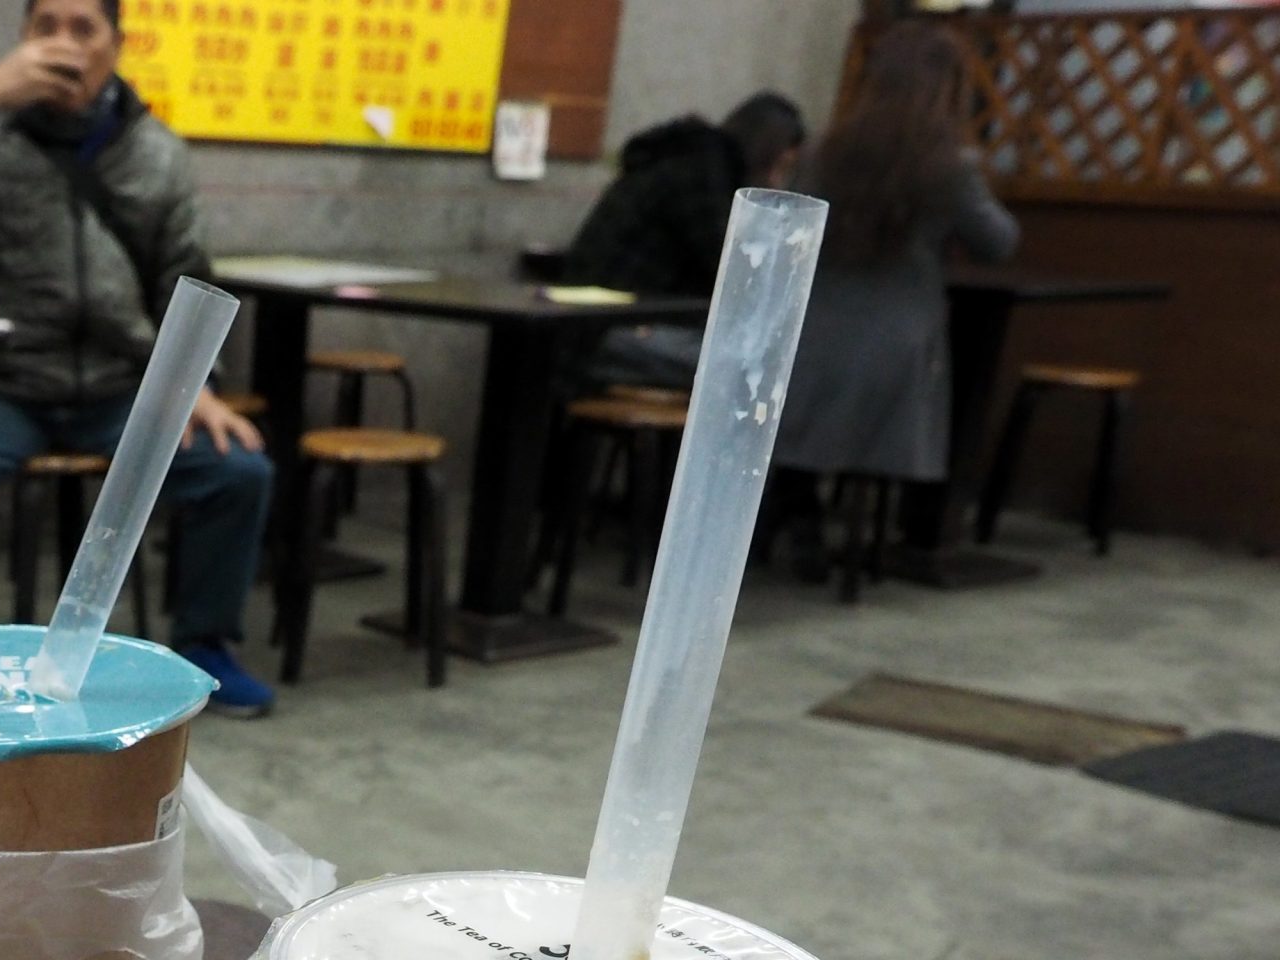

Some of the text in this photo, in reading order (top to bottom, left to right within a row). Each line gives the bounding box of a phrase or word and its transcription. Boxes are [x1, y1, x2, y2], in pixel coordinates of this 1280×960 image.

[426, 909, 457, 927] The
[458, 926, 488, 942] Tea
[488, 942, 514, 951] of
